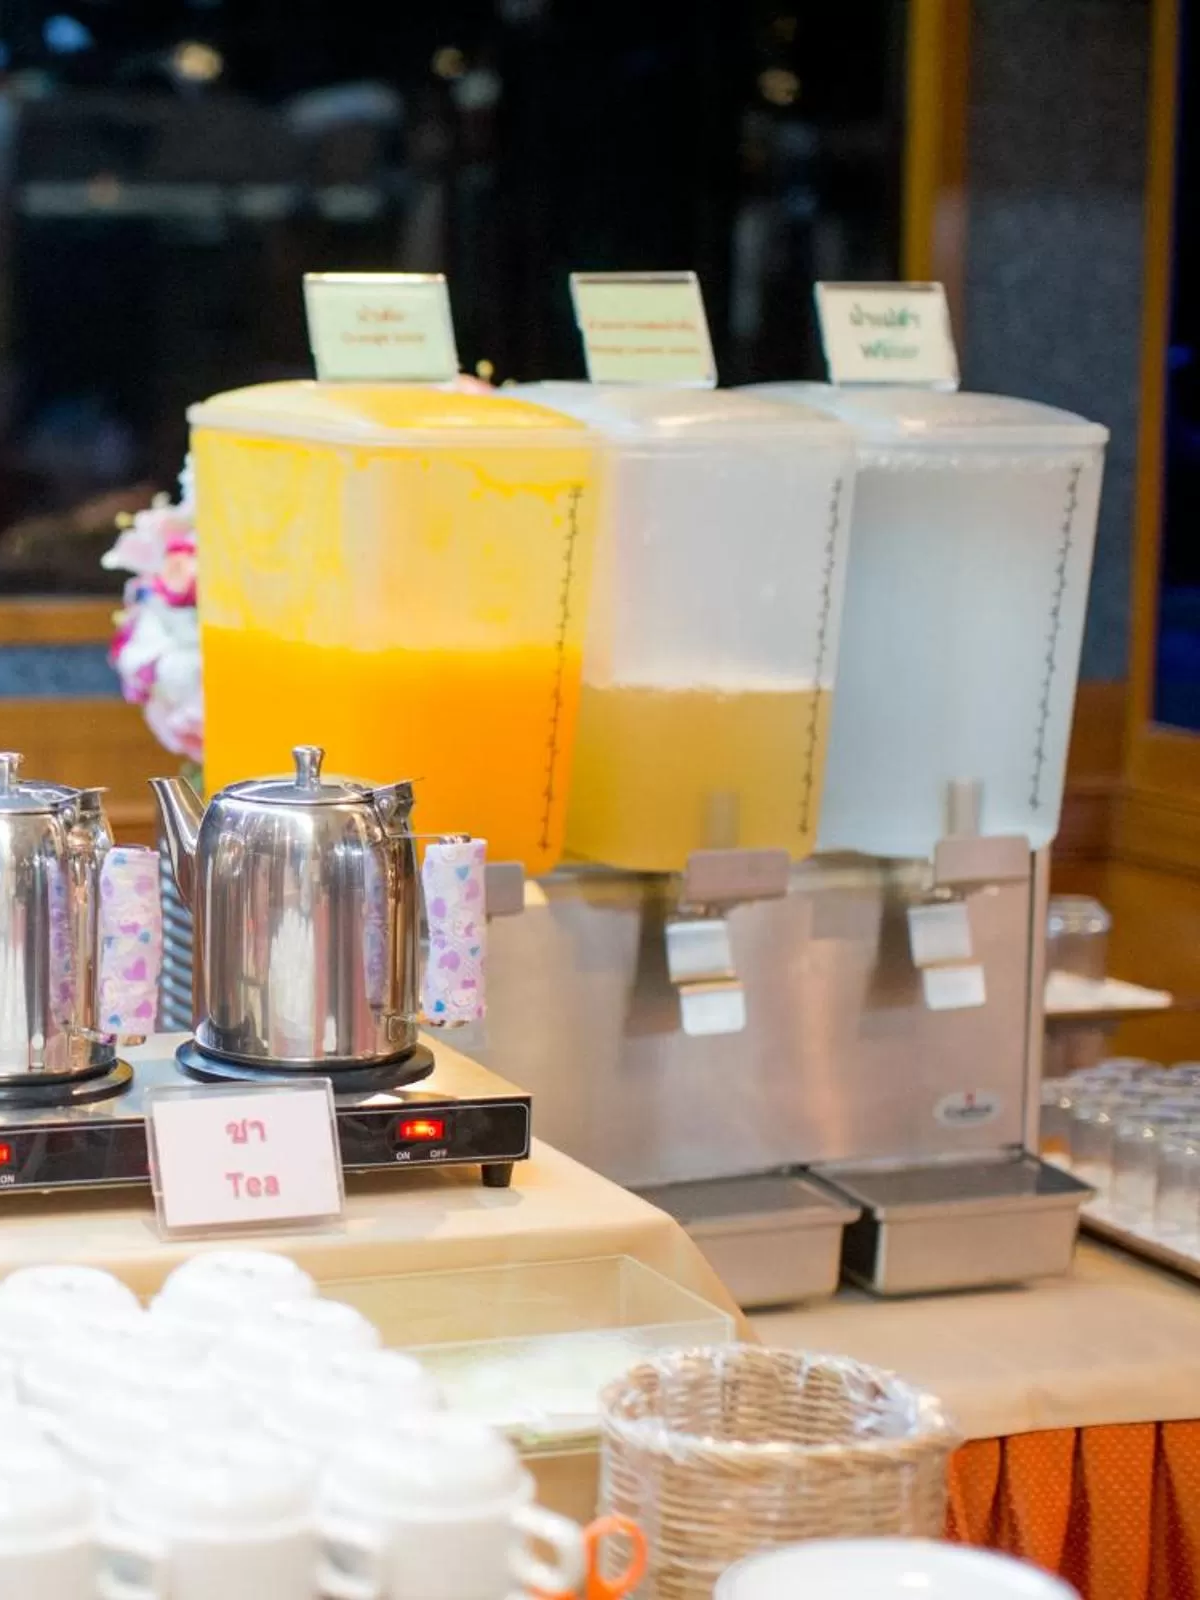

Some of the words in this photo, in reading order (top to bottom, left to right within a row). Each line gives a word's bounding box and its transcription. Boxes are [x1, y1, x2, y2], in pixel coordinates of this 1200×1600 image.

[395, 1151, 411, 1161] ON
[429, 1149, 448, 1159] OFF
[0, 1174, 15, 1185] ON
[225, 1171, 281, 1199] Tea
